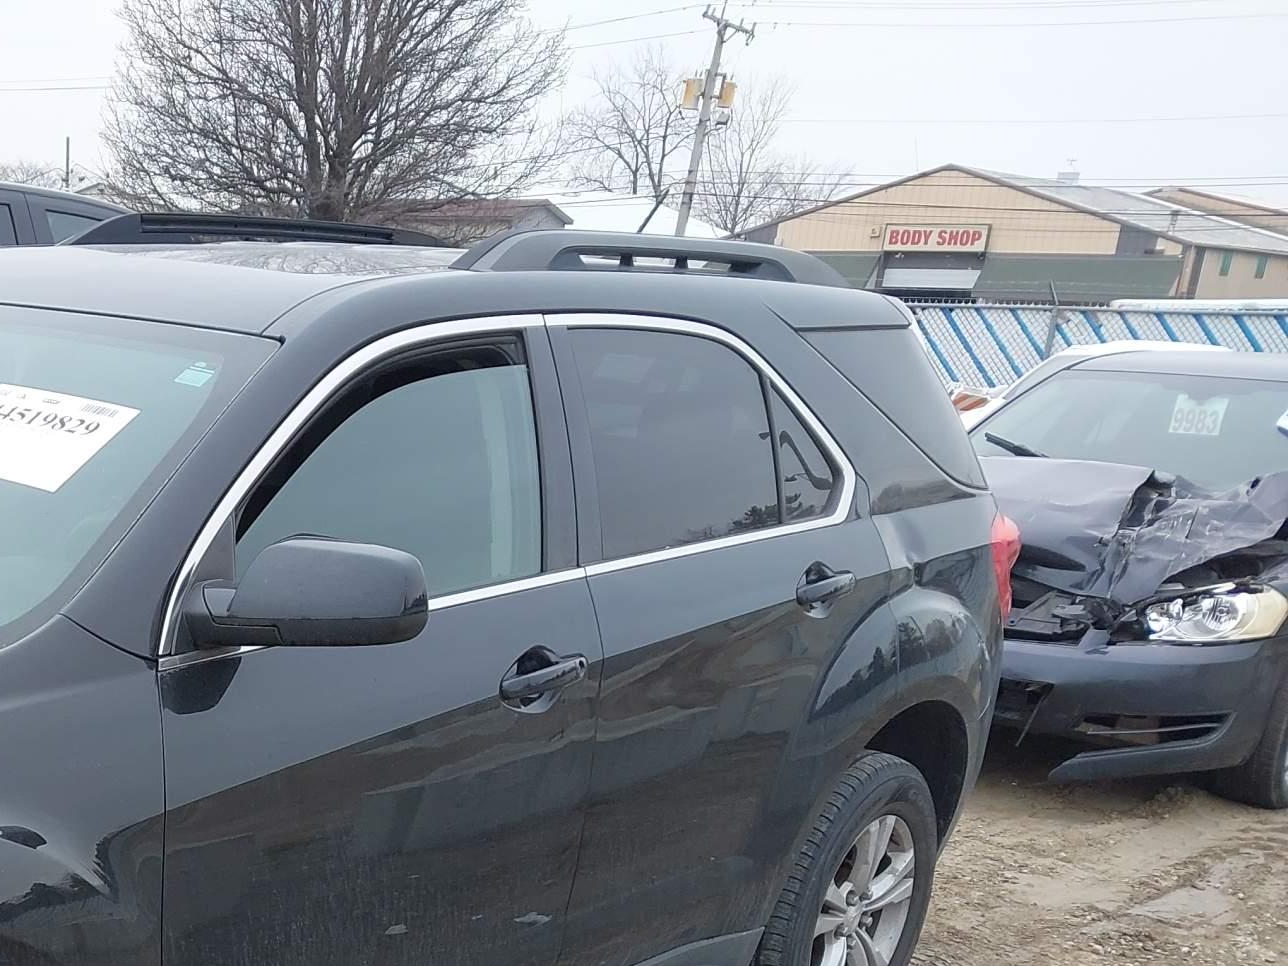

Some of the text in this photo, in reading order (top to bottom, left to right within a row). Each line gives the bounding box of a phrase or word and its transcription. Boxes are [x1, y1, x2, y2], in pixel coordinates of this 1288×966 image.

[888, 229, 982, 246] BODY SHOP
[1172, 408, 1220, 433] 9983
